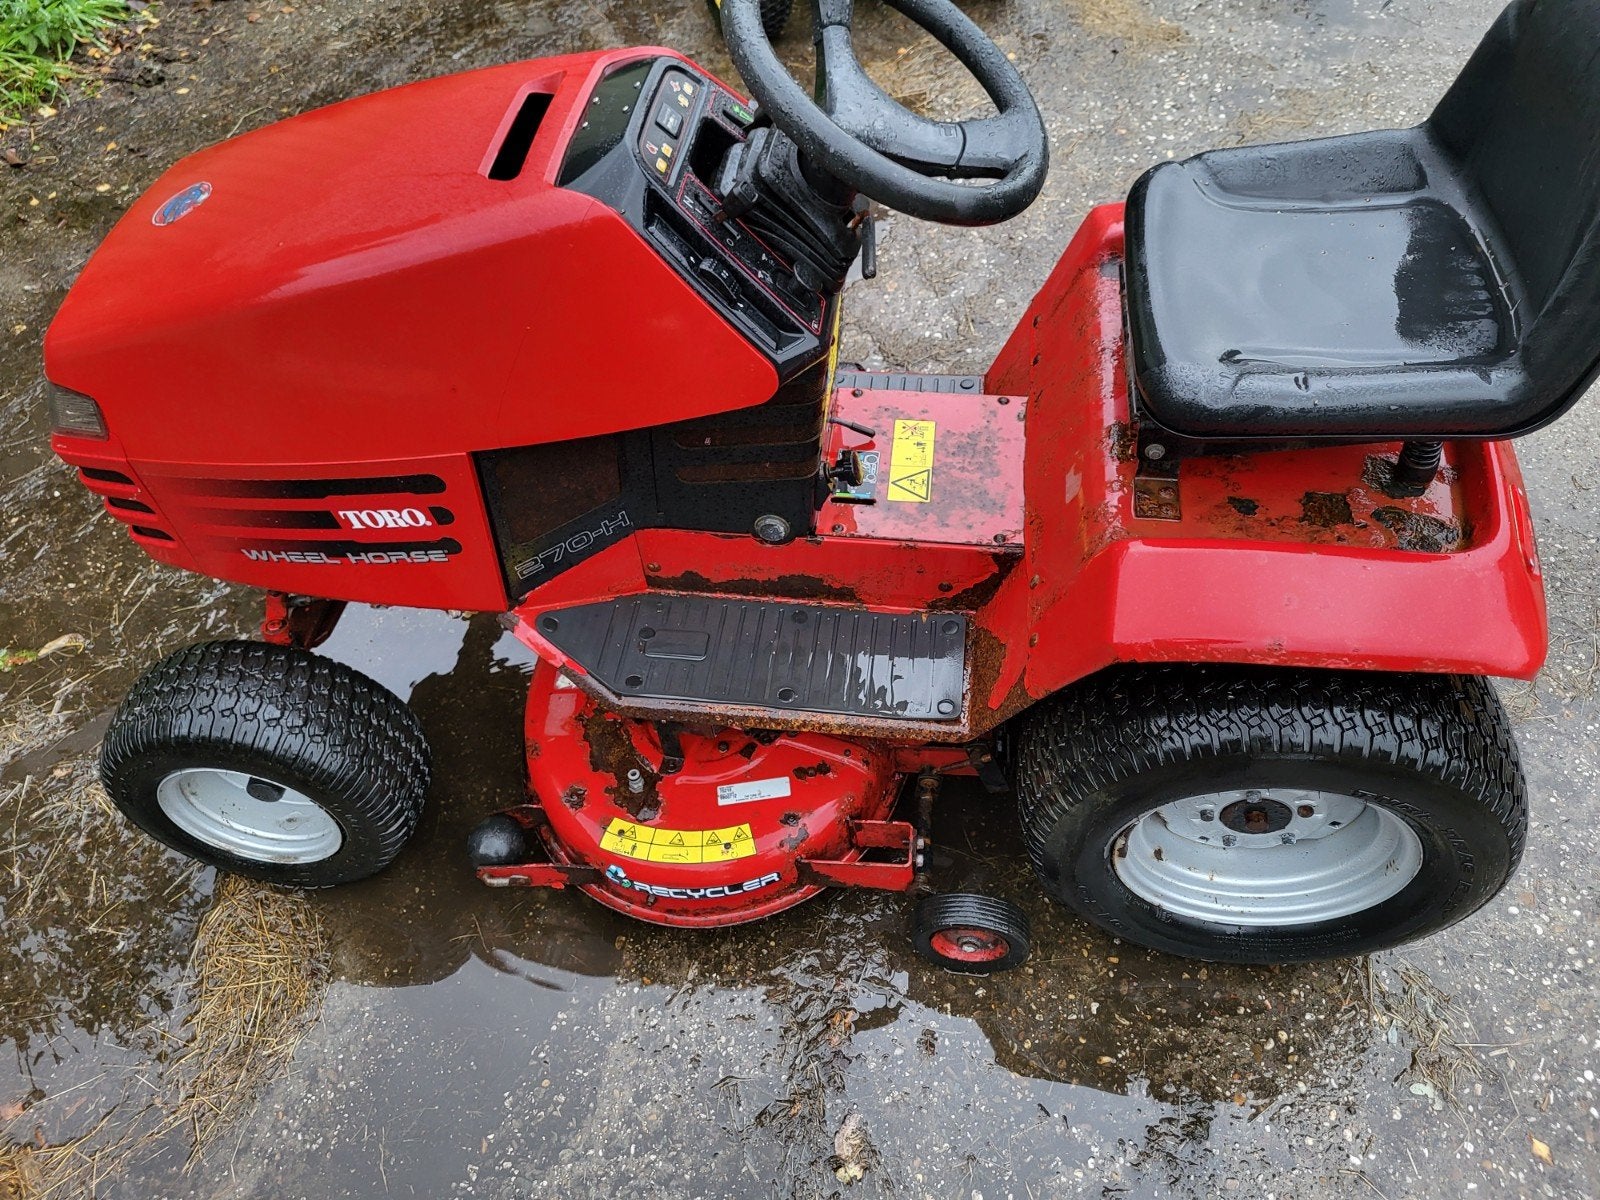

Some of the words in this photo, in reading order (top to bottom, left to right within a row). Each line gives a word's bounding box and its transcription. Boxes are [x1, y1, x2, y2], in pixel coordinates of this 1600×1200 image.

[241, 549, 341, 564] WHEEL
[346, 550, 448, 564] HORSE
[515, 511, 629, 579] 270-H
[634, 872, 780, 898] RECYCLER
